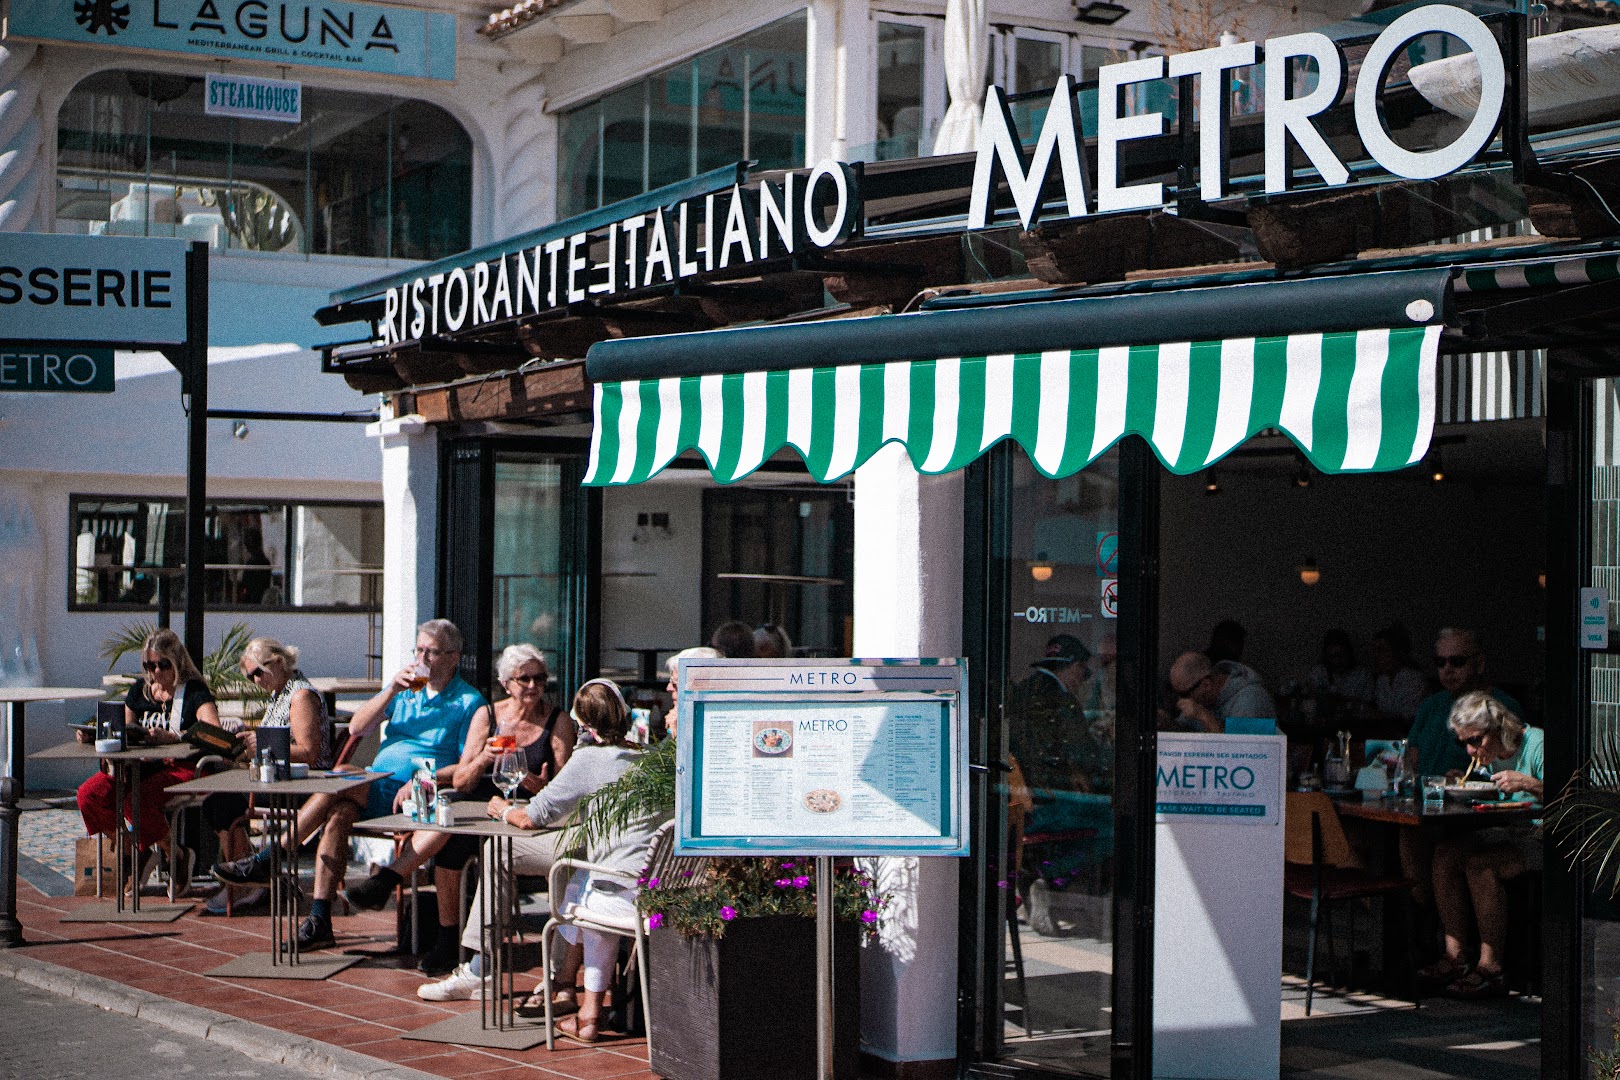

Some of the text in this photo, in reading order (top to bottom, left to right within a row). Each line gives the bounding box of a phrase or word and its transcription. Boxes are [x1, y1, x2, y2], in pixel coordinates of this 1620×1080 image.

[153, 0, 400, 53] LAGUNA
[187, 38, 262, 52] MEDITERRANEAN
[264, 46, 289, 56] GRILL
[301, 51, 343, 61] COCKTAIL
[208, 80, 299, 114] STEAKHOUSE
[968, 4, 1504, 231] METRO
[384, 158, 848, 345] RISTORANTE ITALIANO
[0, 266, 172, 308] SSERIE
[789, 671, 857, 685] METRO
[798, 719, 848, 732] METRO
[1231, 752, 1268, 760] SENTADOS
[1156, 764, 1255, 790] METRO
[1180, 805, 1202, 813] WAIT
[1216, 806, 1228, 814] BE
[1229, 806, 1261, 815] SEATED
